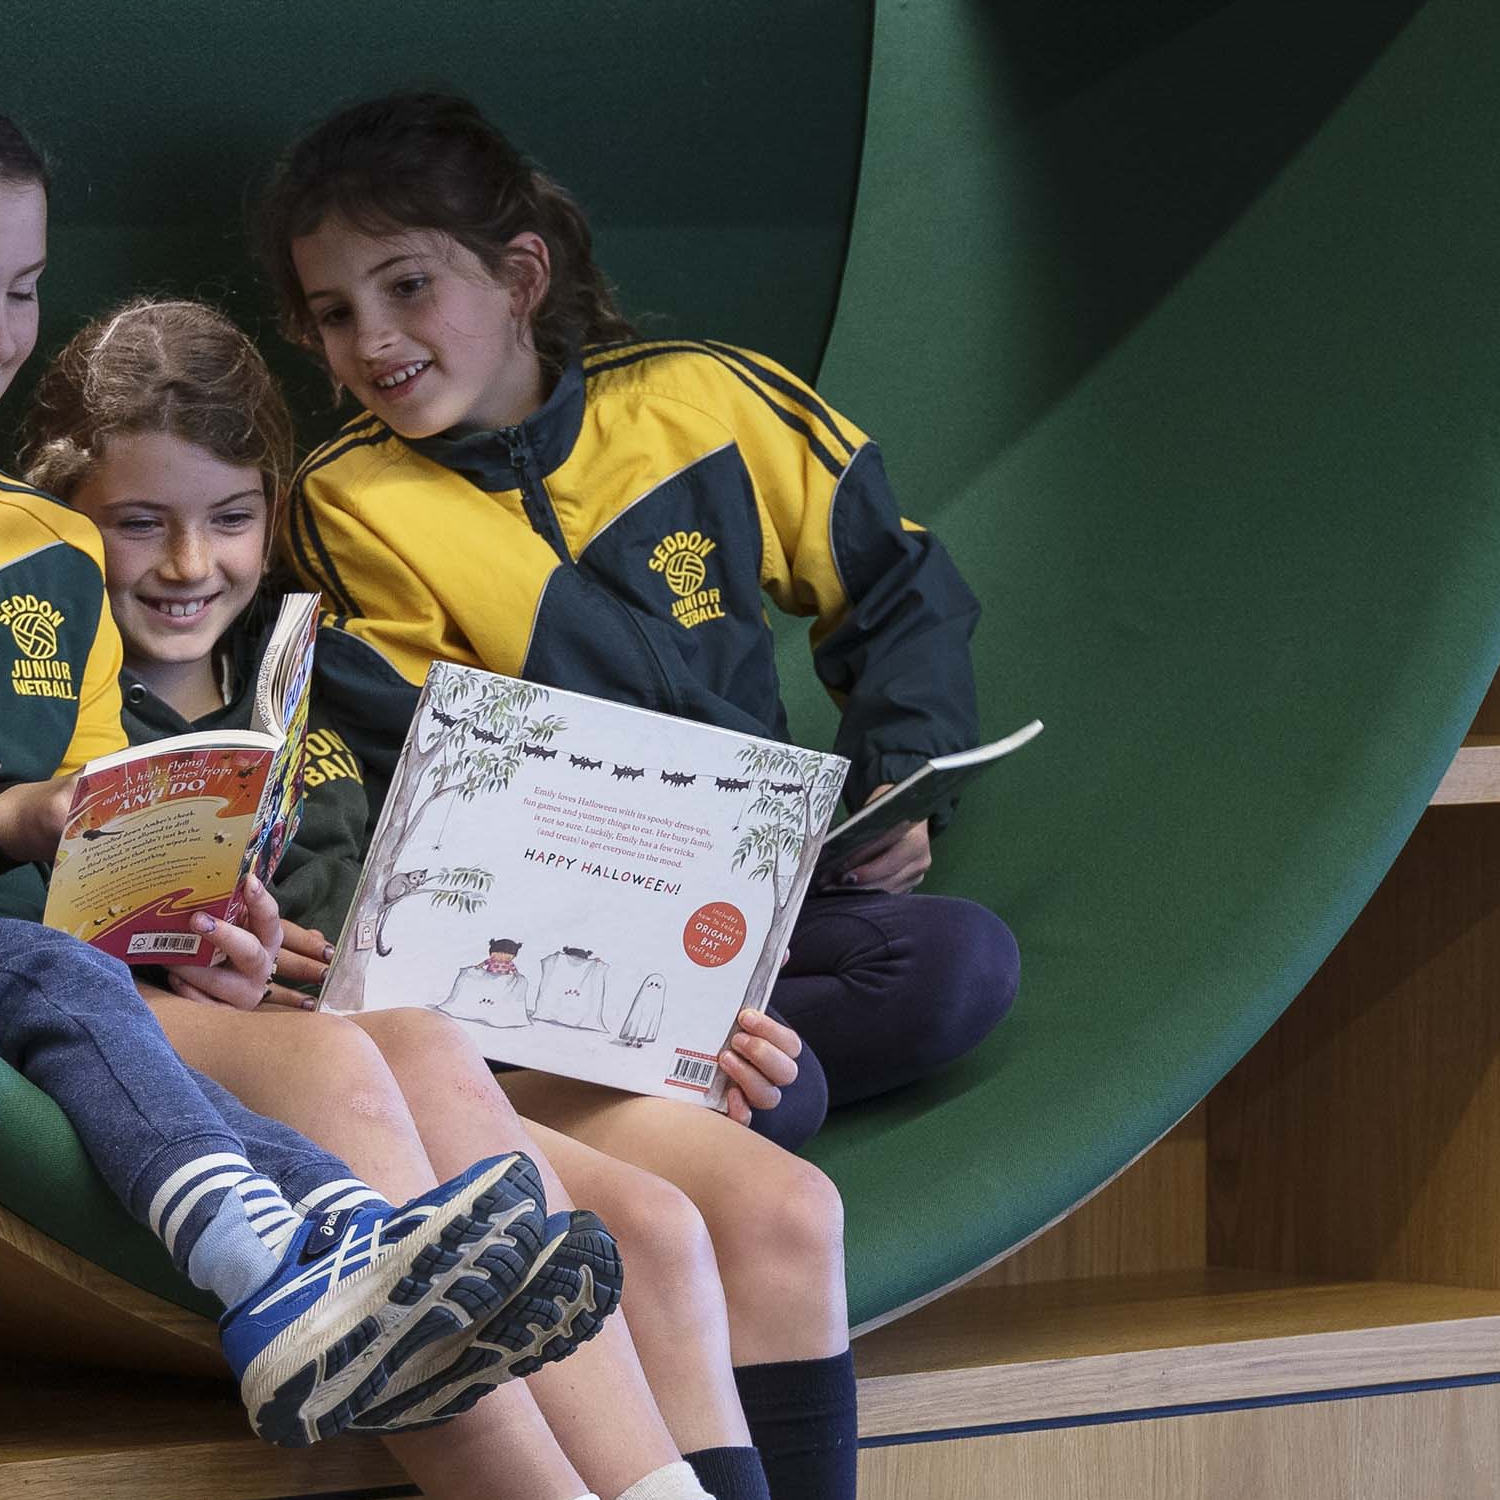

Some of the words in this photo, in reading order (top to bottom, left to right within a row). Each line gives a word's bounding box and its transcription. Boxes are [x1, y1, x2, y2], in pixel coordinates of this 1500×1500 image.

[648, 531, 717, 573] SEDDON
[671, 587, 721, 617] JUNIOR
[11, 659, 72, 681] JUNIOR
[12, 679, 78, 700] NETBALL
[102, 780, 157, 806] adventure
[164, 770, 198, 782] series
[200, 766, 233, 778] from
[123, 776, 133, 787] A
[137, 758, 203, 781] high-flying
[116, 787, 164, 813] ANH
[170, 779, 206, 795] DO
[533, 785, 558, 800] Emily
[558, 791, 577, 804] loves
[577, 795, 618, 814] Halloween
[618, 807, 636, 818] with
[636, 811, 647, 820] its
[647, 814, 674, 828] spooky
[523, 796, 537, 808] fun
[537, 801, 561, 813] games
[562, 807, 578, 817] and
[578, 811, 607, 824] yummy
[607, 816, 631, 831] things
[632, 823, 640, 832] to
[640, 827, 655, 836] eat.
[655, 828, 671, 839] Her
[671, 832, 689, 845] busy
[689, 836, 714, 851] family
[533, 813, 541, 821] is
[541, 815, 555, 825] not
[555, 819, 565, 827] so
[565, 822, 583, 832] sure.
[585, 825, 614, 840] Luckily,
[615, 832, 639, 847] Emily
[638, 838, 652, 849] has
[659, 842, 673, 853] few
[673, 847, 695, 859] tricks
[537, 827, 555, 838] (and
[555, 830, 580, 844] treats)
[580, 838, 589, 847] to
[589, 841, 602, 852] get
[602, 843, 636, 859] everyone
[636, 850, 646, 860] in
[646, 853, 659, 864] the
[659, 857, 683, 869] mood.
[523, 847, 577, 870] HAPPY
[580, 860, 682, 896] HALLOWEEN!
[695, 922, 736, 946] ORIGAMI
[712, 918, 720, 926] to
[720, 920, 735, 933] fold
[700, 937, 720, 951] BAT
